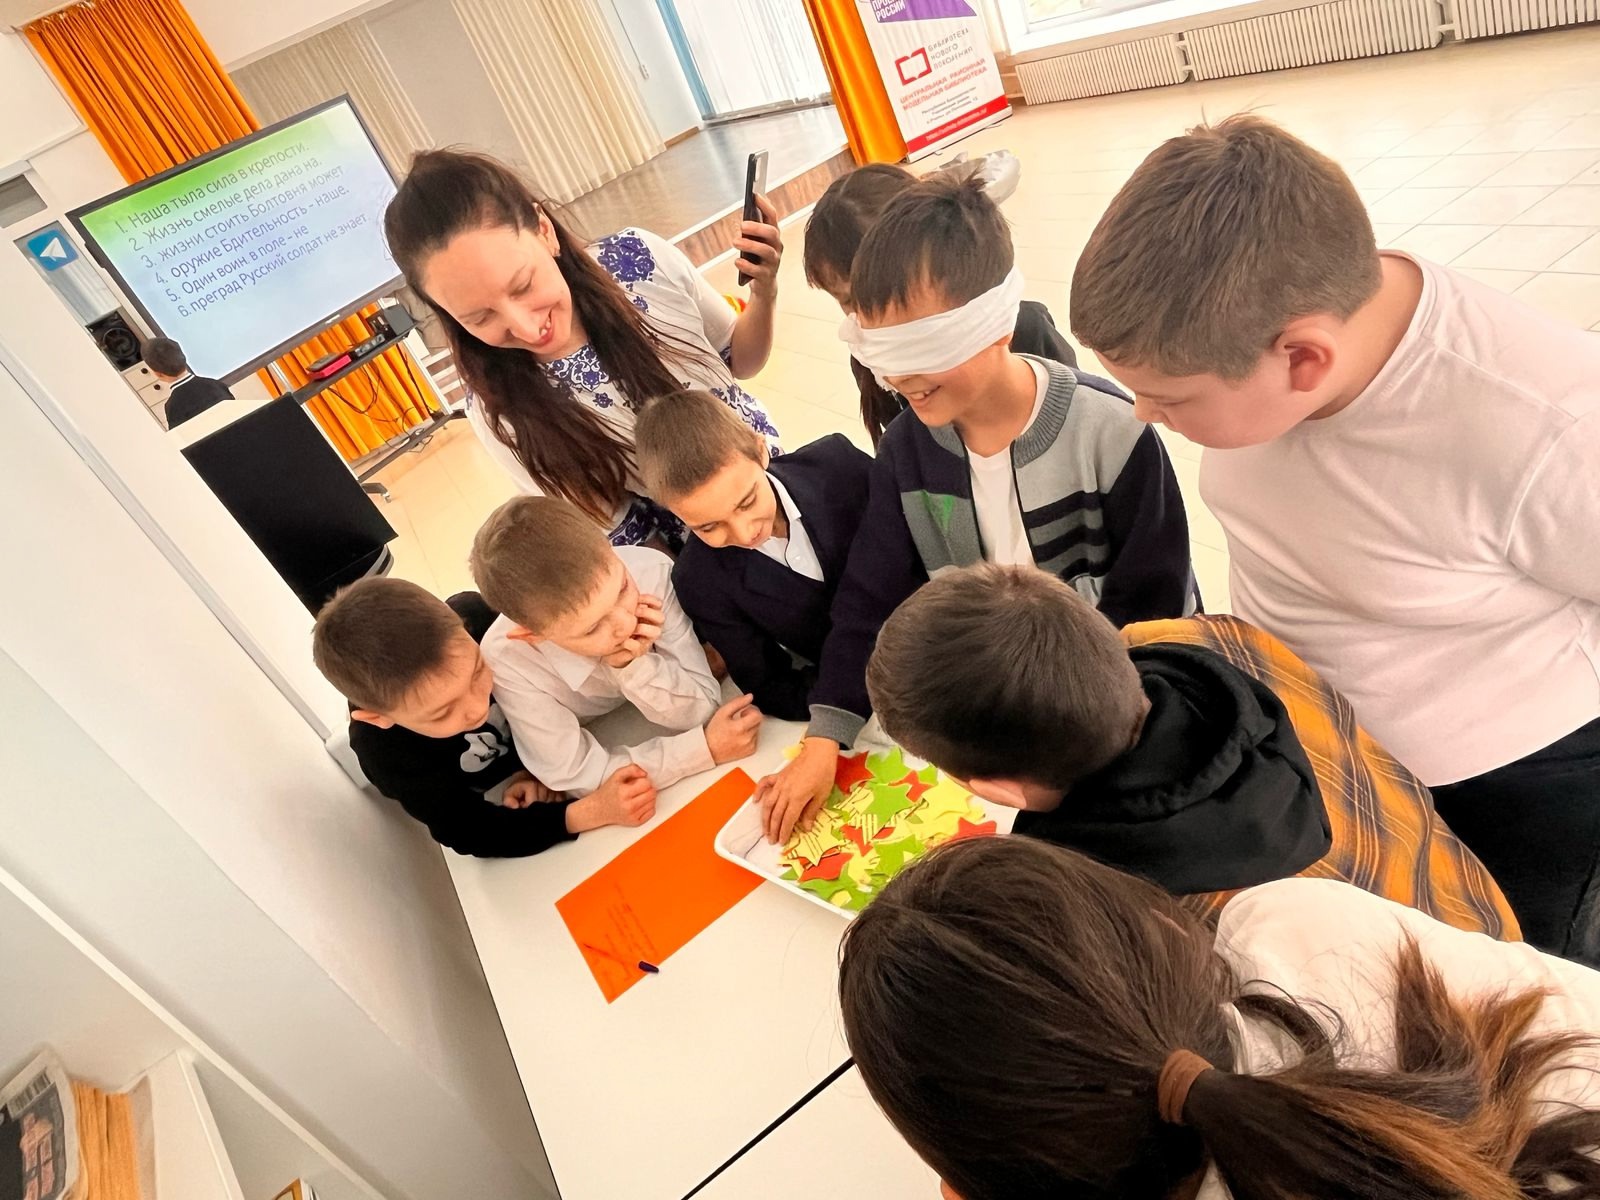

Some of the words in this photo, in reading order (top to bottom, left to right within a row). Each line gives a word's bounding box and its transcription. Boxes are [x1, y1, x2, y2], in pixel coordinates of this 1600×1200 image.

[872, 0, 895, 11] ПРОЕ
[875, 0, 906, 21] РОССИИ
[930, 43, 959, 60] НОВОГО
[128, 203, 171, 228] Наша
[170, 187, 206, 209] тыла
[206, 173, 239, 194] сила
[237, 168, 248, 180] в
[247, 142, 310, 176] крепости.
[140, 254, 157, 269] 3.
[157, 233, 205, 262] жизни
[204, 213, 250, 239] стоить
[247, 183, 309, 218] Болтовня
[307, 164, 344, 190] может
[143, 217, 194, 245] Жизнь
[193, 192, 244, 222] смелые
[243, 179, 273, 202] дела
[275, 166, 303, 187] дана
[302, 157, 323, 171] на.
[155, 271, 169, 285] 4.
[170, 246, 223, 278] оружие
[220, 205, 308, 253] Бдительность
[314, 185, 350, 207] наше.
[165, 288, 181, 302] 5.
[181, 271, 218, 295] Один
[249, 251, 258, 261] в
[258, 237, 287, 257] поле
[293, 224, 310, 239] не
[177, 305, 192, 318] 6.
[190, 279, 242, 312] преград
[239, 253, 288, 285] Русский
[287, 236, 324, 262] солдат
[323, 228, 339, 243] не
